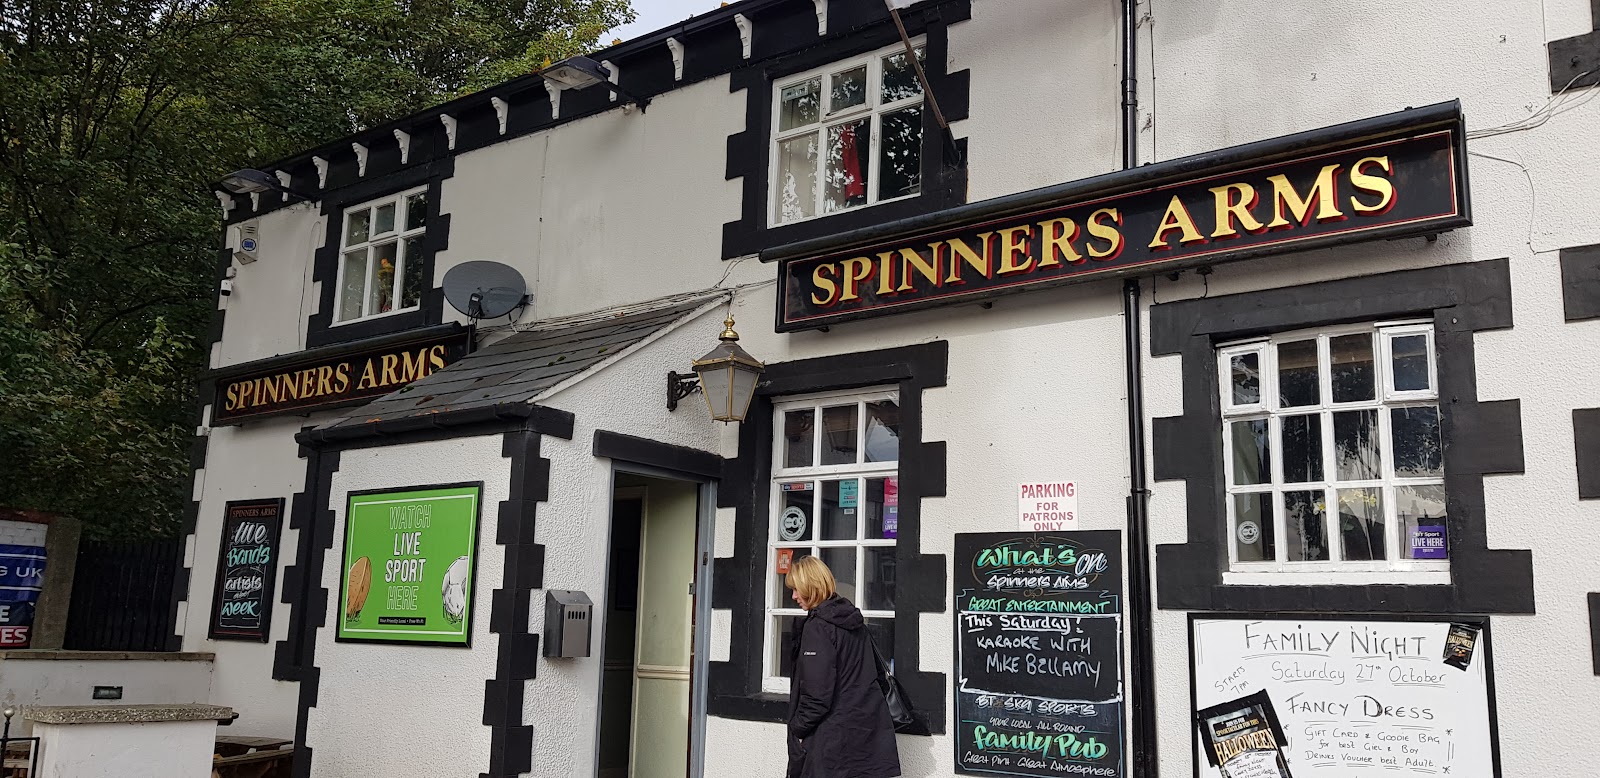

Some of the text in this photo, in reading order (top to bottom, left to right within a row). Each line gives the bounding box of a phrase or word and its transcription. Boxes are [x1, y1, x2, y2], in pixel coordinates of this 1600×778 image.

[809, 154, 1398, 308] SPINNERS ARMS
[225, 344, 445, 411] SPINNERS ARMS
[1021, 482, 1075, 499] PARKING
[232, 507, 277, 518] SPINNERS ARMS
[1022, 511, 1074, 521] PATRONS
[1036, 501, 1059, 511] FOR
[389, 504, 432, 530] WATCH
[1033, 521, 1063, 531] ONLY
[234, 521, 267, 545] live
[393, 531, 422, 556] LIVE
[1412, 537, 1444, 547] LIVE HERE
[227, 544, 271, 568] Bands
[16, 566, 43, 578] UK
[385, 558, 427, 583] SPORT
[225, 575, 262, 591] artists
[386, 585, 419, 611] HERE
[968, 596, 1111, 614] GREAT ENTERTAINMENT
[221, 601, 260, 617] week
[965, 615, 993, 628] This
[1000, 614, 1071, 635] Saturday
[976, 634, 1091, 655] KARAOKE WITH
[1244, 620, 1426, 661] FAMILY NIGHT
[986, 651, 1021, 673] MIKE
[1214, 665, 1247, 693] STARTS
[1271, 661, 1447, 686] Saturday 27th October
[975, 694, 996, 709] BT
[1035, 700, 1098, 718] SPORTS
[1285, 692, 1435, 721] FANCY DRESS
[989, 717, 1086, 733] YOUR LOCAL ALL ROUND
[1304, 726, 1327, 741] GIFT
[1332, 727, 1359, 739] CARD
[1377, 730, 1410, 742] GOODIE
[1418, 733, 1440, 745] BAG
[1053, 733, 1109, 760] Pub
[1213, 728, 1278, 766] HALLOWEEN
[1318, 738, 1331, 750] for
[1338, 740, 1356, 750] best
[964, 750, 989, 764] Great
[1017, 756, 1048, 770] Great
[1341, 752, 1373, 763] VOUCHER
[1380, 756, 1397, 766] best
